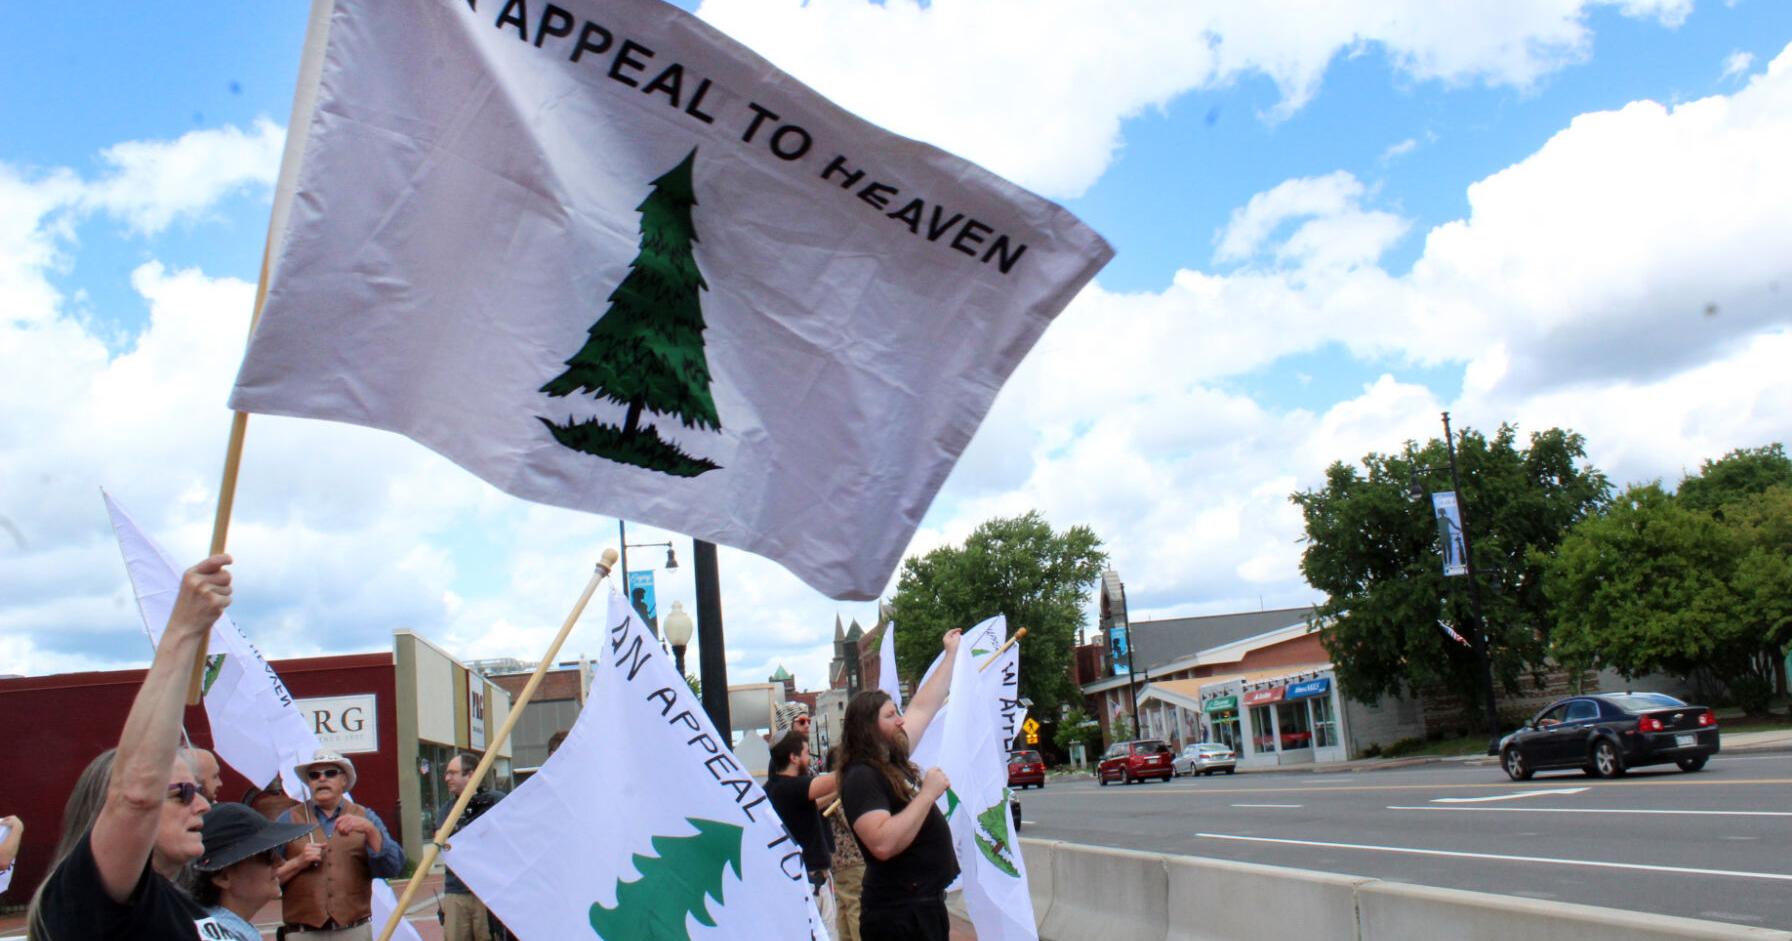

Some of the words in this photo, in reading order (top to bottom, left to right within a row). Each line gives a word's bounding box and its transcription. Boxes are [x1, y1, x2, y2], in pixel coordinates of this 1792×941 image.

[495, 0, 715, 125] APPEAL
[741, 102, 813, 161] TO
[821, 155, 1027, 275] HEAVEN
[301, 706, 365, 735] RG
[612, 616, 651, 681] AN
[647, 687, 768, 823] APPEAL
[767, 824, 803, 881] TO
